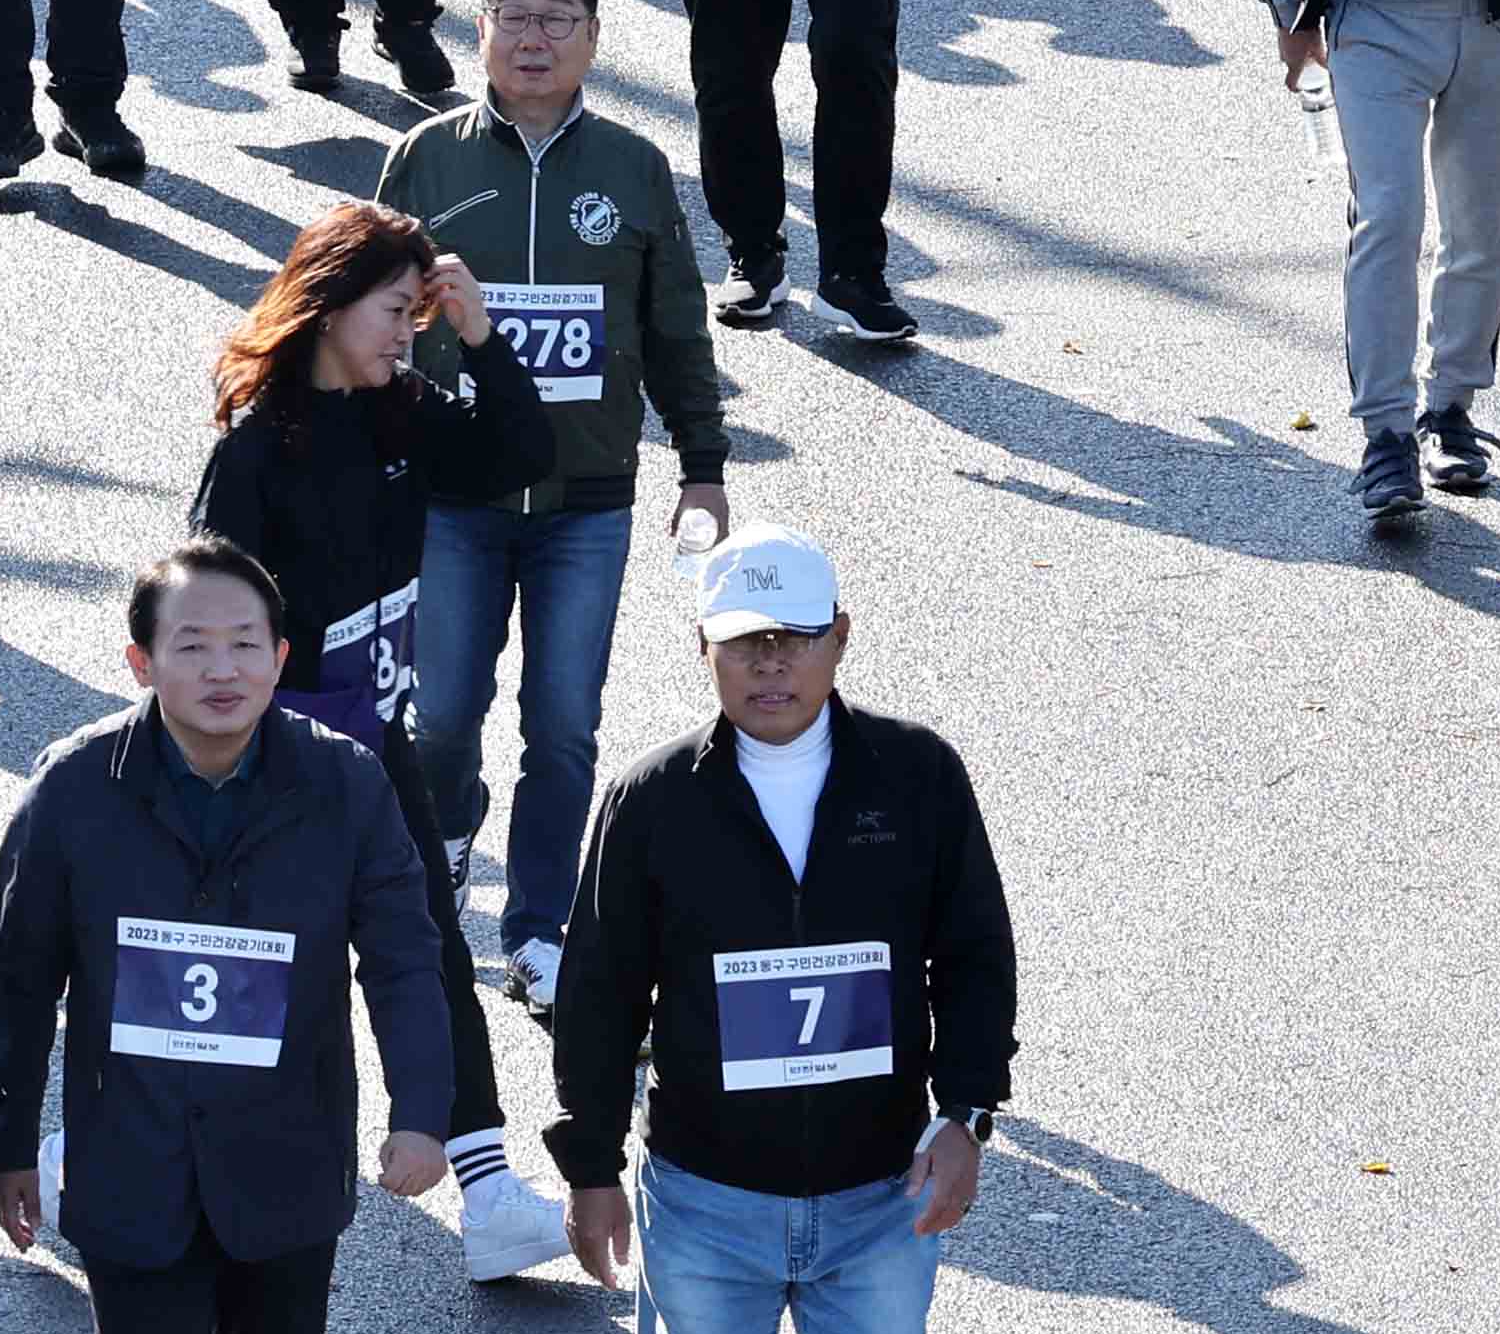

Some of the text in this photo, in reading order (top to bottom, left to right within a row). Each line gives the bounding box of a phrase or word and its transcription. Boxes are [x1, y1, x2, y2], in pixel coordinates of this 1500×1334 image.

[496, 317, 592, 368] 278
[127, 926, 159, 942] 2023
[161, 930, 185, 945] 동구
[723, 960, 758, 975] 2023
[760, 958, 785, 973] 동구
[180, 962, 219, 1023] 3
[790, 985, 826, 1045] 7
